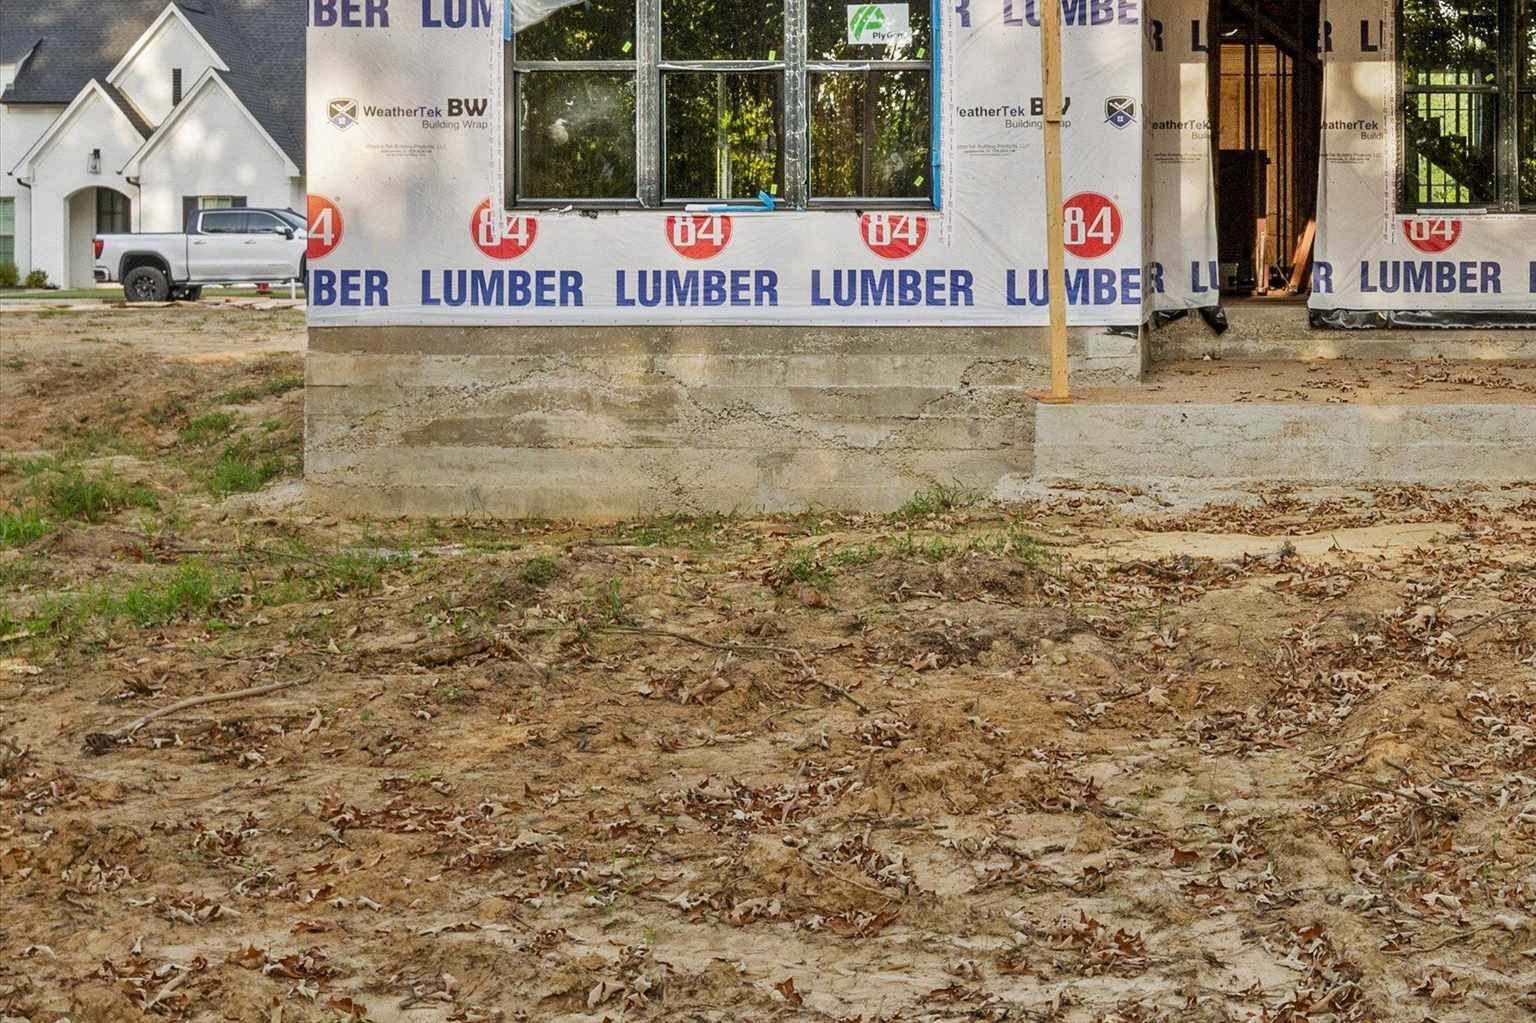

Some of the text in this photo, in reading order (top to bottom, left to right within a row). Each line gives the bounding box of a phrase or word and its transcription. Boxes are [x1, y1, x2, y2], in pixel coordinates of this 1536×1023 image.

[363, 98, 489, 118] WeatherTek BW
[421, 119, 489, 131] Building Wrap
[956, 105, 1026, 118] eatherTek
[1004, 118, 1043, 130] Building
[1063, 206, 1113, 246] 84
[420, 269, 585, 307] LUMBER
[615, 269, 779, 307] LUMBER
[810, 268, 975, 307] LUMBER
[1360, 260, 1502, 294] LUMBER
